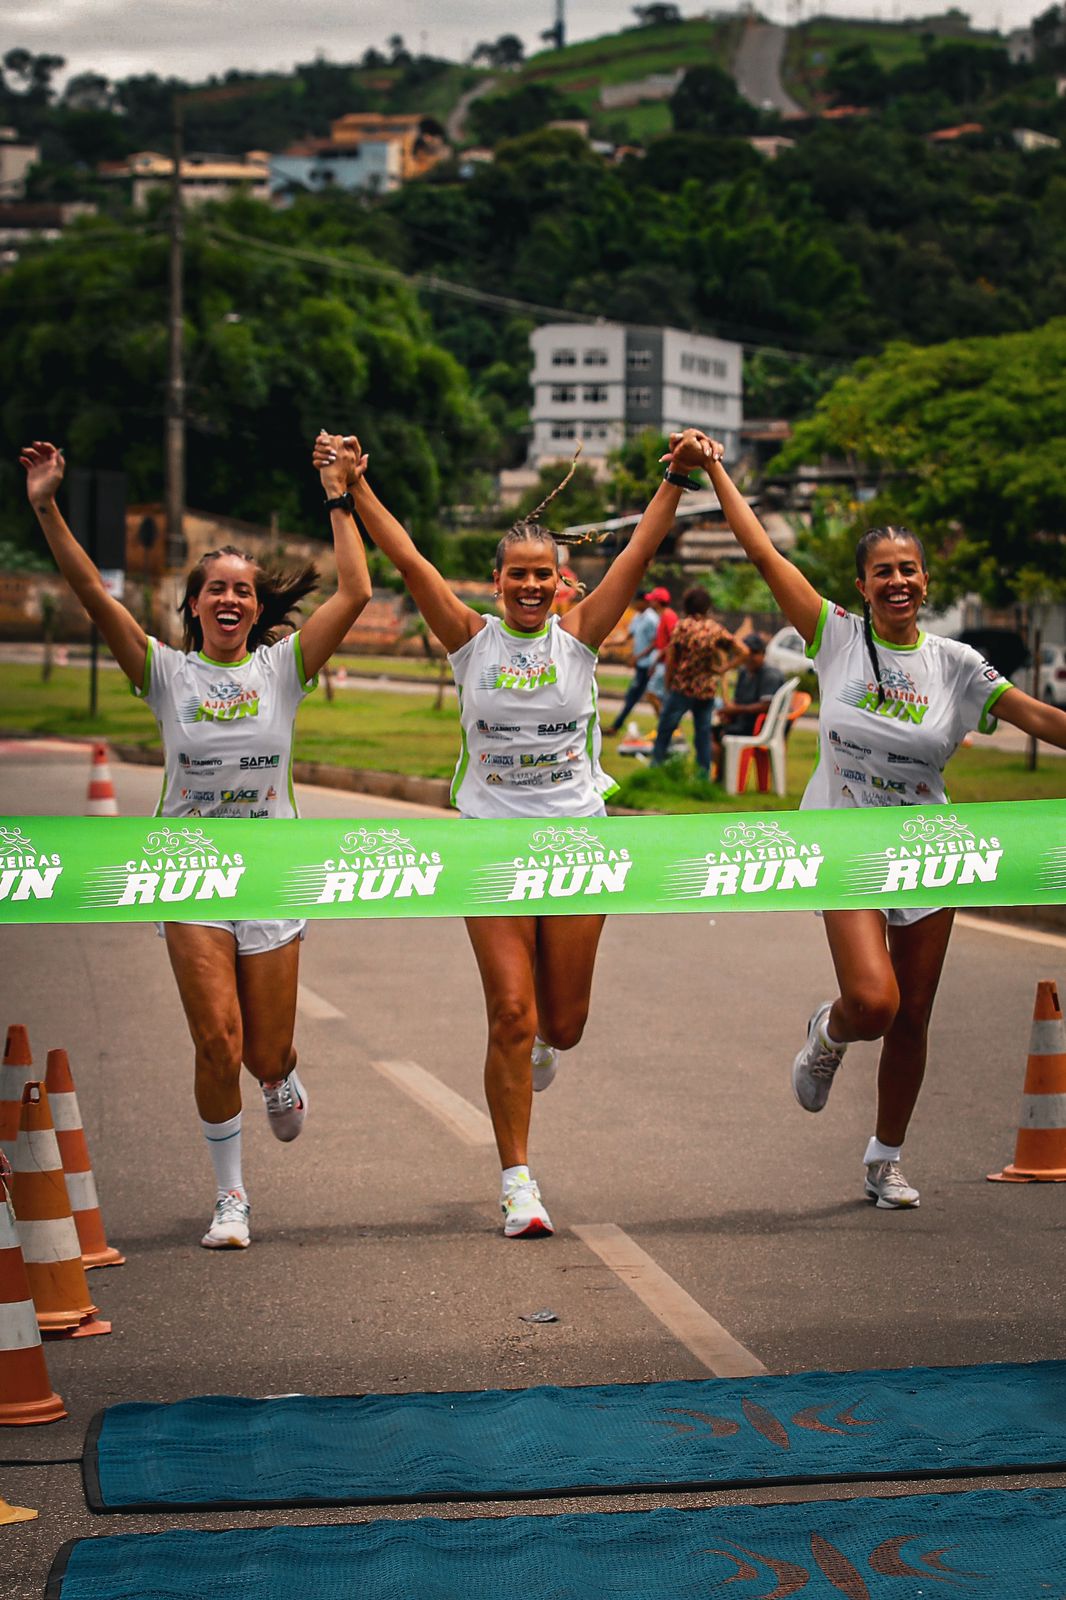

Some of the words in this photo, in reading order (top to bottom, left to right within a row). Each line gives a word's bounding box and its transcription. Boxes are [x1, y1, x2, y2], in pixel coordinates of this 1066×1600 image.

[126, 853, 244, 873] CAJAZEIRAS
[324, 852, 441, 871] CAJAZEIRAS
[513, 849, 630, 869] CAJAZEIRAS
[705, 843, 821, 865] CAJAZEIRAS
[885, 837, 1000, 859] CAJAZEIRAS
[316, 865, 444, 904] RUN
[507, 861, 632, 901] RUN
[700, 856, 824, 897] RUN
[881, 849, 1003, 892] RUN
[118, 867, 246, 906] RUN
